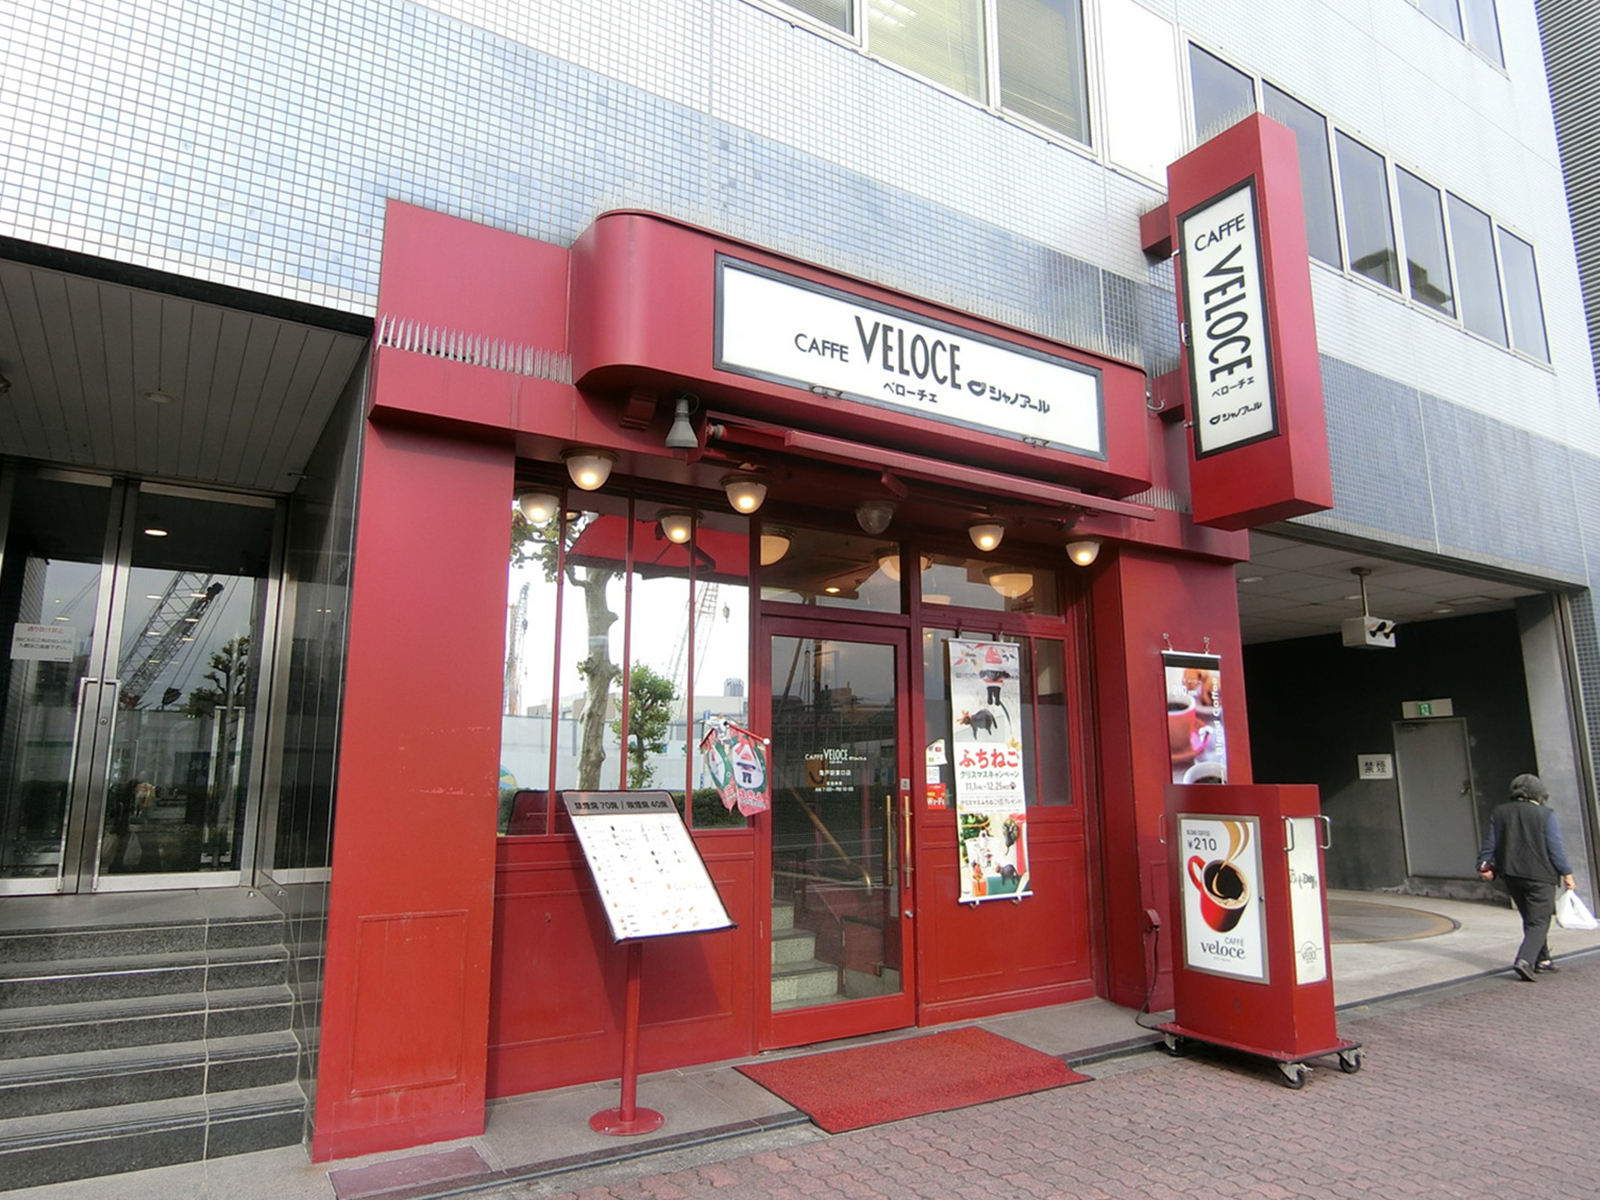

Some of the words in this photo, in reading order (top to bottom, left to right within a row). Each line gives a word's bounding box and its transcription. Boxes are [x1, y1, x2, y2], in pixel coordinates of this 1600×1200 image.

[1194, 213, 1245, 251] CAFFE
[1203, 244, 1254, 383] VELOCE
[794, 333, 849, 363] CAFFE
[854, 315, 961, 390] VELOCE
[883, 382, 938, 403] ベローチェ
[1211, 376, 1254, 397] ベローチェ
[989, 385, 1050, 414] シャノアール
[823, 748, 849, 761] VELOCE
[959, 749, 1019, 769] ふちねこ
[1364, 761, 1386, 773] 禁煙
[1187, 837, 1217, 851] ¥210
[1200, 940, 1246, 960] veloce
